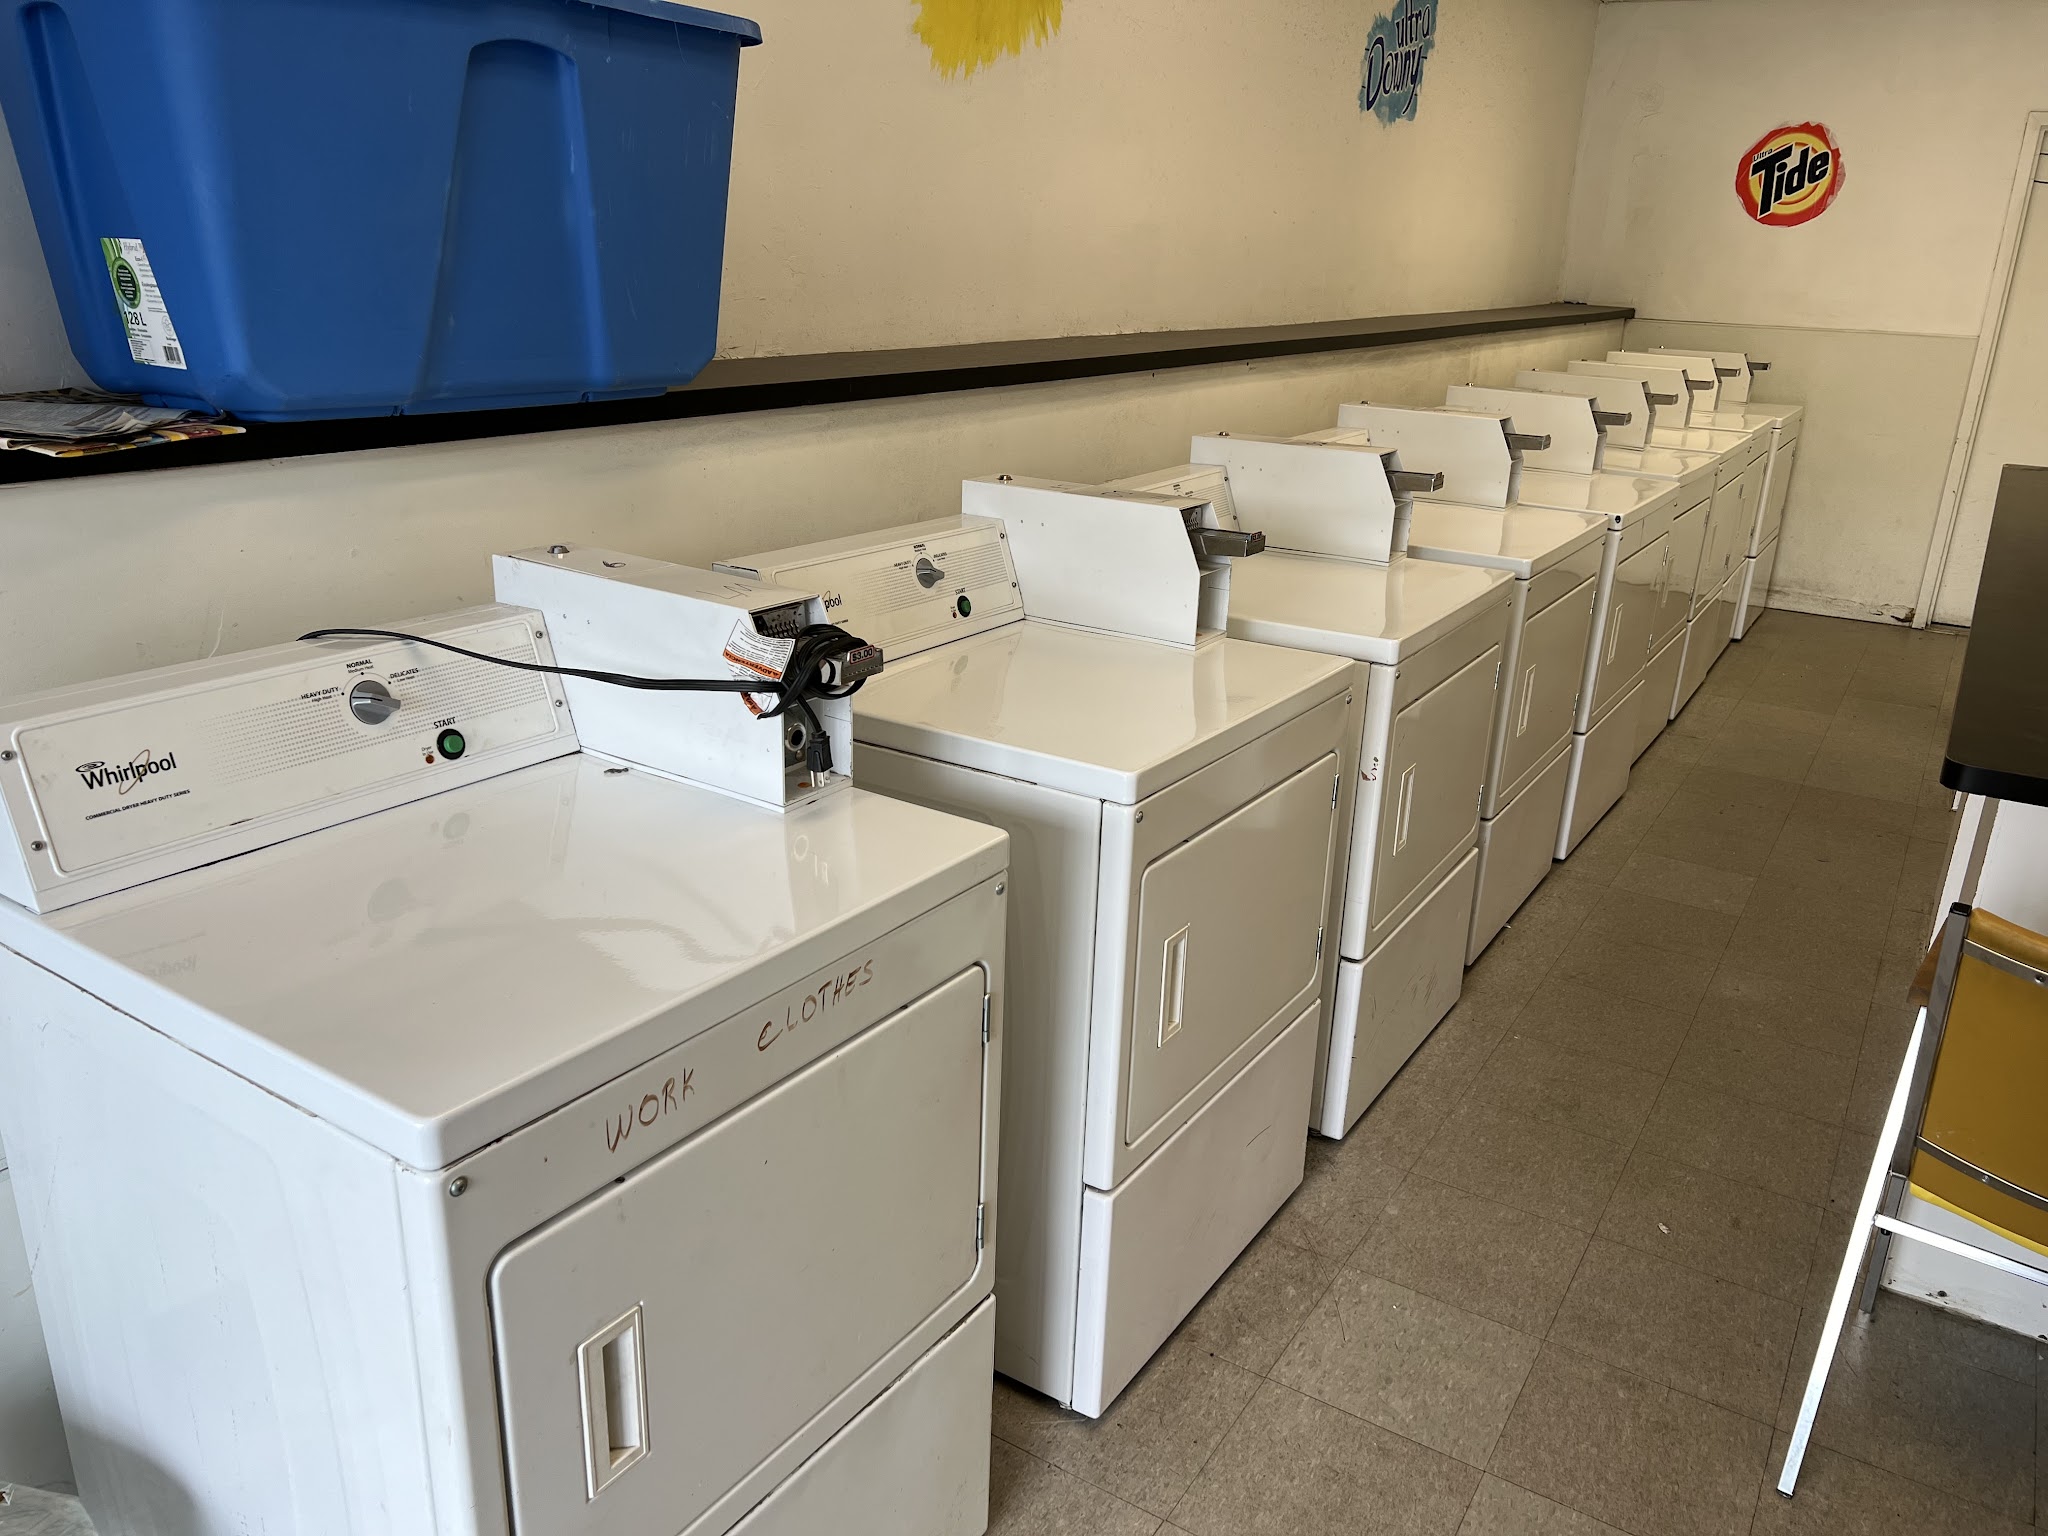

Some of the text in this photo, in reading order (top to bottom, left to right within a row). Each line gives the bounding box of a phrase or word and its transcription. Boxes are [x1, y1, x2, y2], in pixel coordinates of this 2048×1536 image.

[1396, 0, 1431, 48] ultra
[1366, 36, 1423, 115] Downy
[1752, 148, 1774, 162] Ultra
[1750, 143, 1831, 217] Tide
[124, 311, 147, 327] 128 L
[346, 659, 373, 670] NORMAL
[347, 665, 364, 675] Medium
[390, 667, 419, 679] DELICATES
[301, 686, 339, 700] HEAVY DUTY
[312, 696, 322, 704] High
[433, 716, 456, 729] START
[79, 752, 177, 790] Whirlpool
[85, 789, 191, 821] COMMERCIAL DRYER HEAVY DUTY SERIES
[605, 959, 874, 1154] WORK CLOTHES
